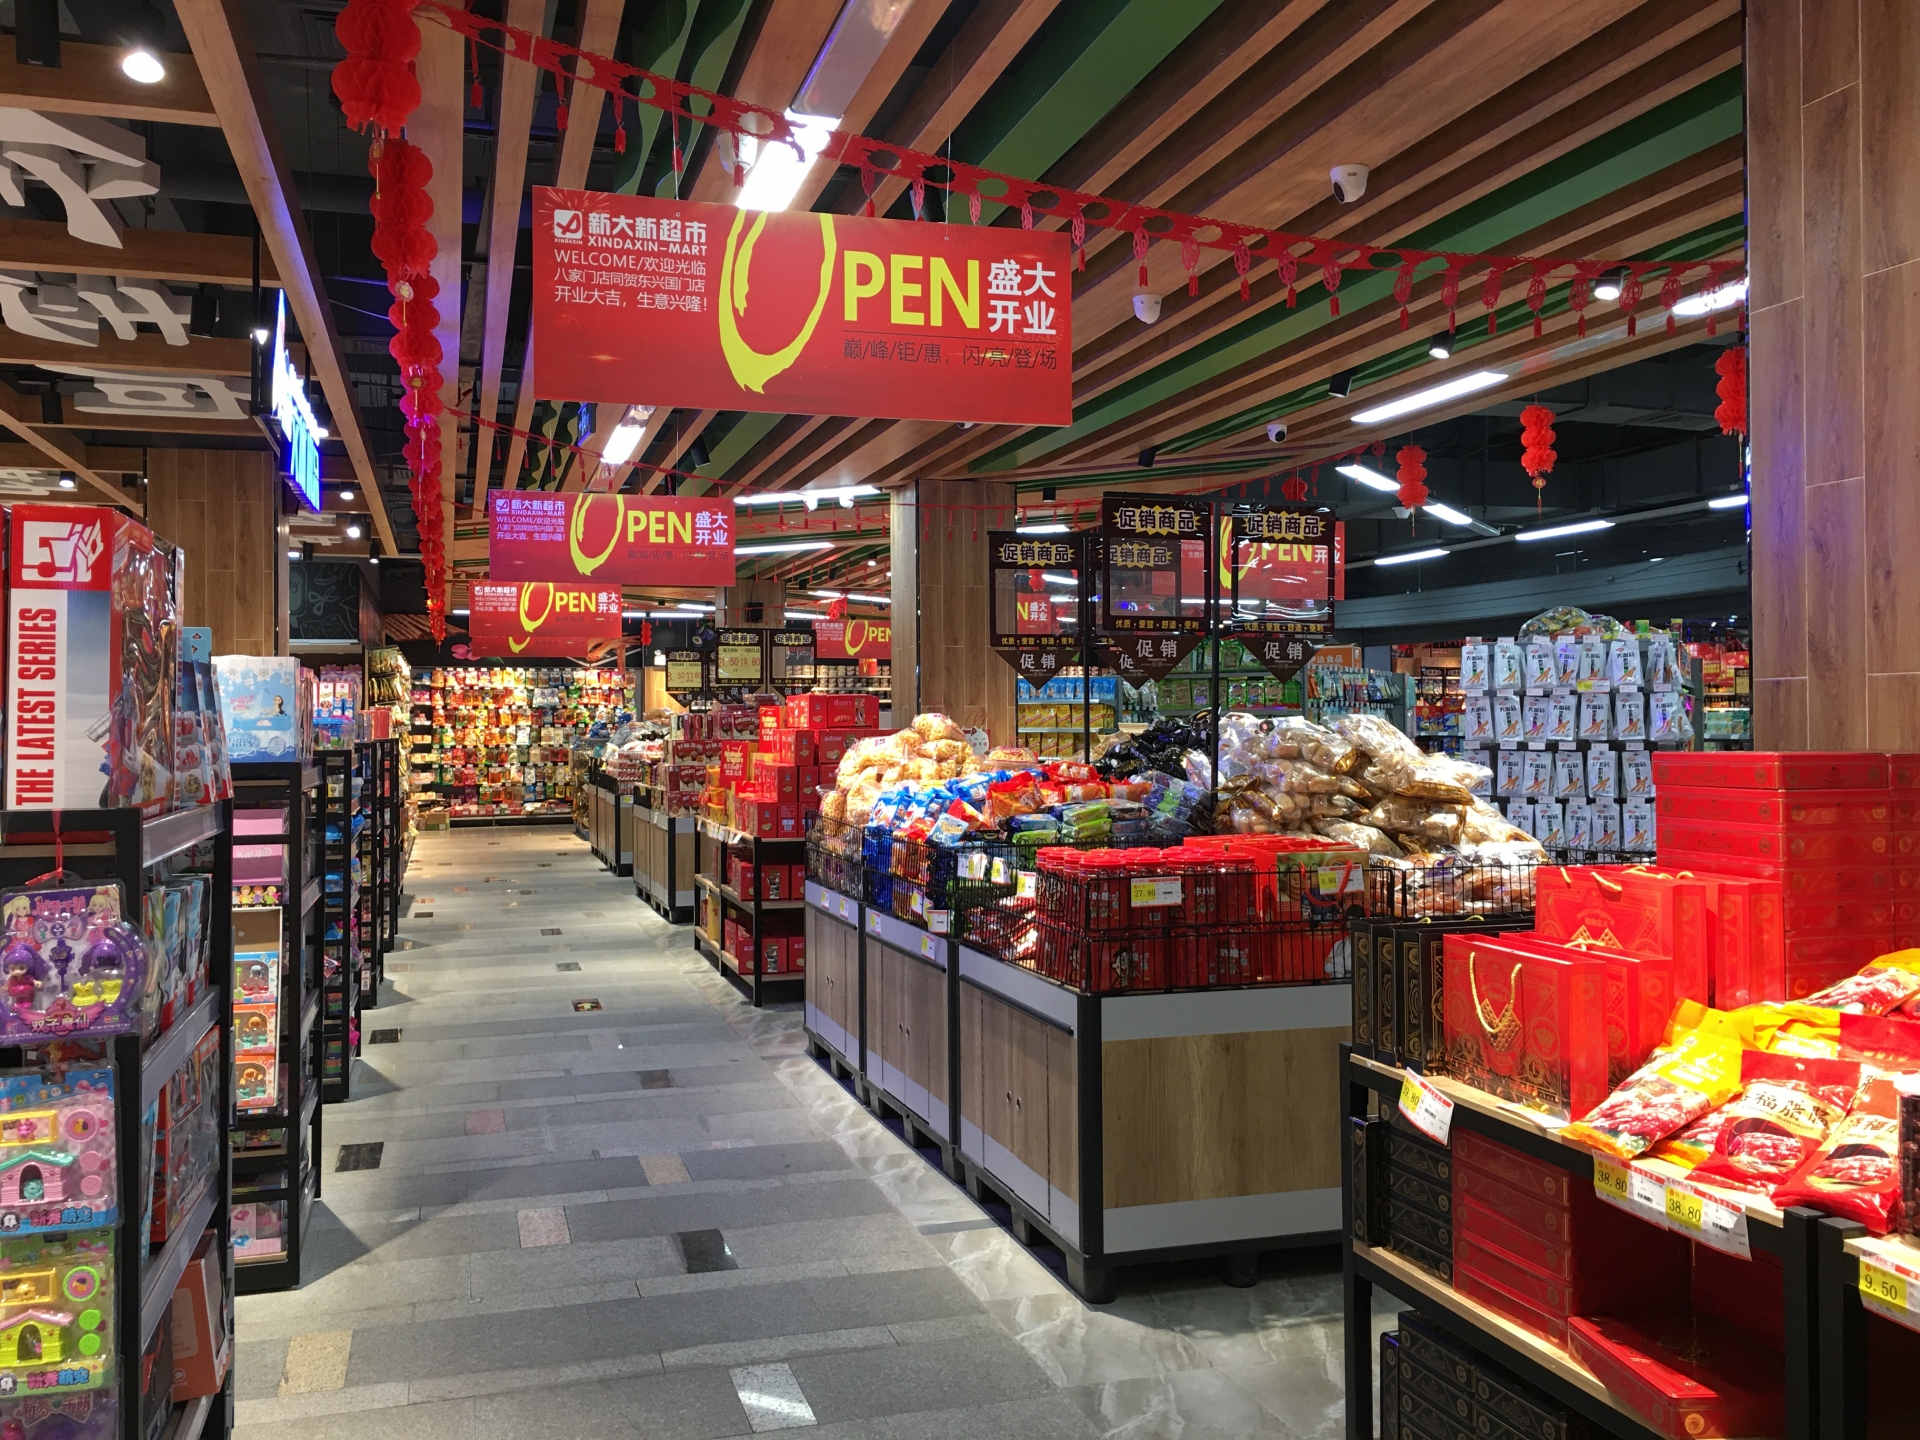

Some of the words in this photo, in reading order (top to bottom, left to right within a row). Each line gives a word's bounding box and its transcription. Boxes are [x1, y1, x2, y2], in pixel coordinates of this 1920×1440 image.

[588, 212, 707, 245] 新大新超市
[588, 235, 707, 256] XINDAXIN-MART
[554, 249, 706, 276] WELCOME/欢迎光临
[554, 268, 706, 293] 八家门店同贺东兴国门店
[987, 259, 1056, 298] 盛大
[719, 208, 980, 394] OPEN
[987, 300, 1057, 335] 开业
[511, 499, 565, 511] 新大新超市
[695, 511, 729, 528] 盛大
[1119, 507, 1195, 532] 促销商品
[1247, 514, 1321, 537] 促销商品
[570, 493, 692, 576] OPEN
[695, 529, 729, 546] 开业
[1003, 543, 1070, 562] 促销商品
[520, 582, 596, 633] OPEN
[598, 592, 619, 603] 盛大
[598, 603, 619, 614] 开业
[17, 607, 57, 680] SERIES
[1136, 639, 1178, 658] 促销
[1263, 641, 1303, 660] 促销
[1019, 653, 1056, 670] 促销
[16, 687, 56, 762] LATEST
[15, 768, 54, 806] THE
[1134, 888, 1156, 898] 27.80
[1402, 1085, 1420, 1106] 29.80
[1597, 1169, 1628, 1193] 38.80
[1668, 1198, 1701, 1223] 38.80
[1864, 1274, 1898, 1300] 9.50
